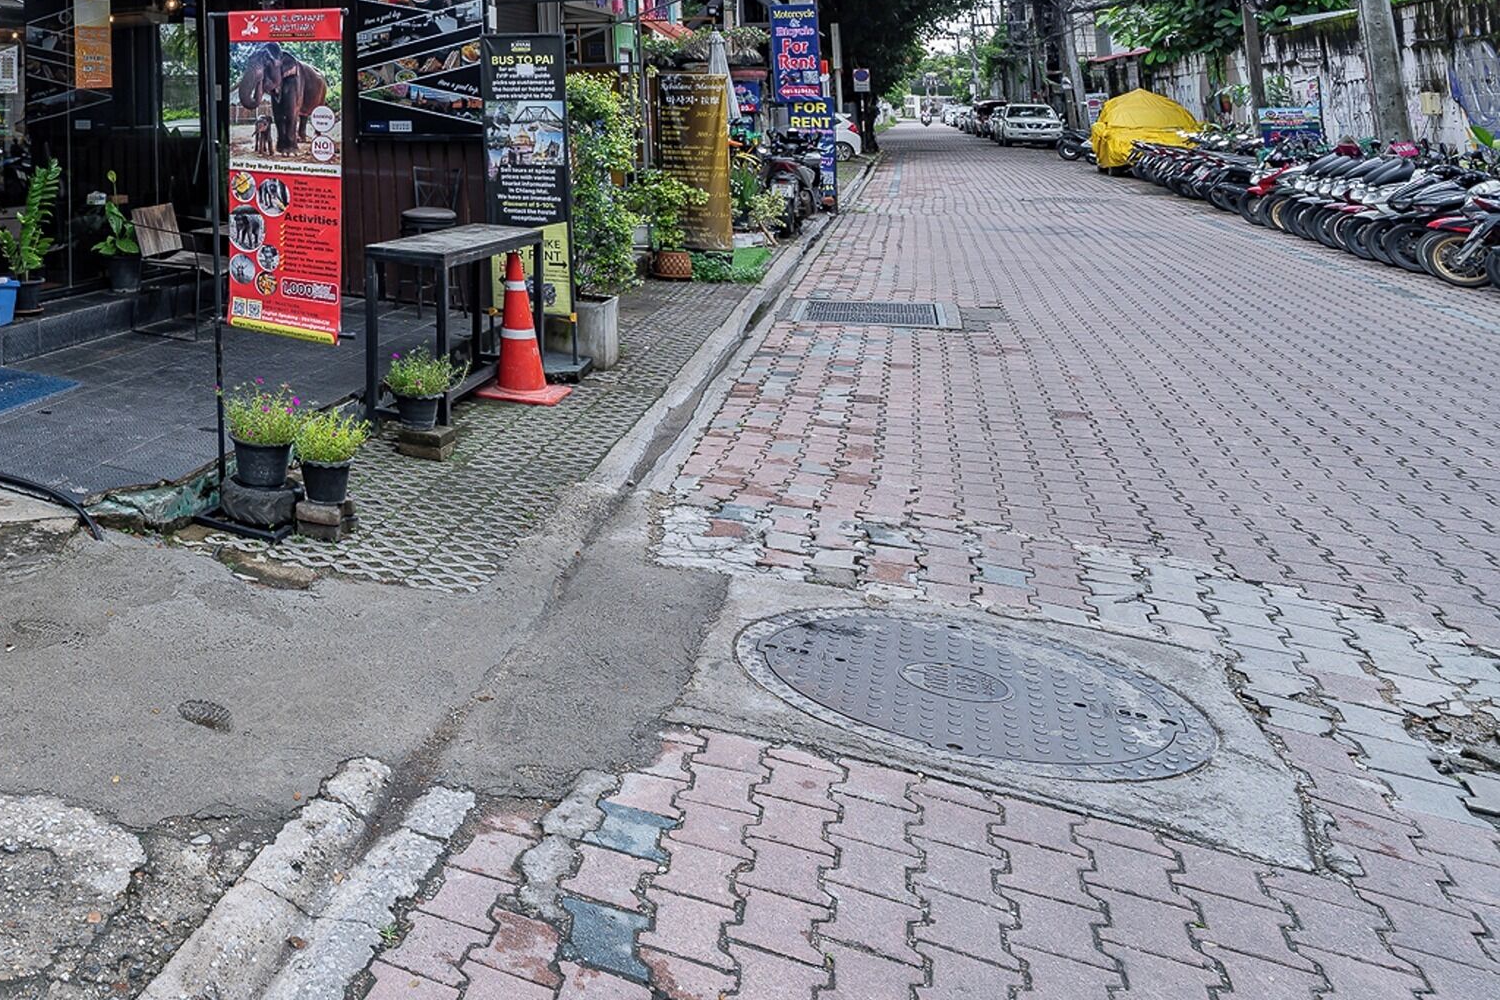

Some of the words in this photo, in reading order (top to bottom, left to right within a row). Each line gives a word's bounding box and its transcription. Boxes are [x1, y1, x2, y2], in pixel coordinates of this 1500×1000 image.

[781, 38, 809, 55] For
[491, 56, 514, 65] BUS
[516, 55, 532, 64] TO
[535, 55, 554, 64] PAI
[778, 53, 816, 71] Rent
[665, 95, 694, 104] 마사지
[794, 103, 827, 114] FOR
[791, 116, 831, 128] RENT
[303, 166, 337, 174] Experience
[515, 187, 536, 195] Chiang
[284, 212, 338, 226] Activities
